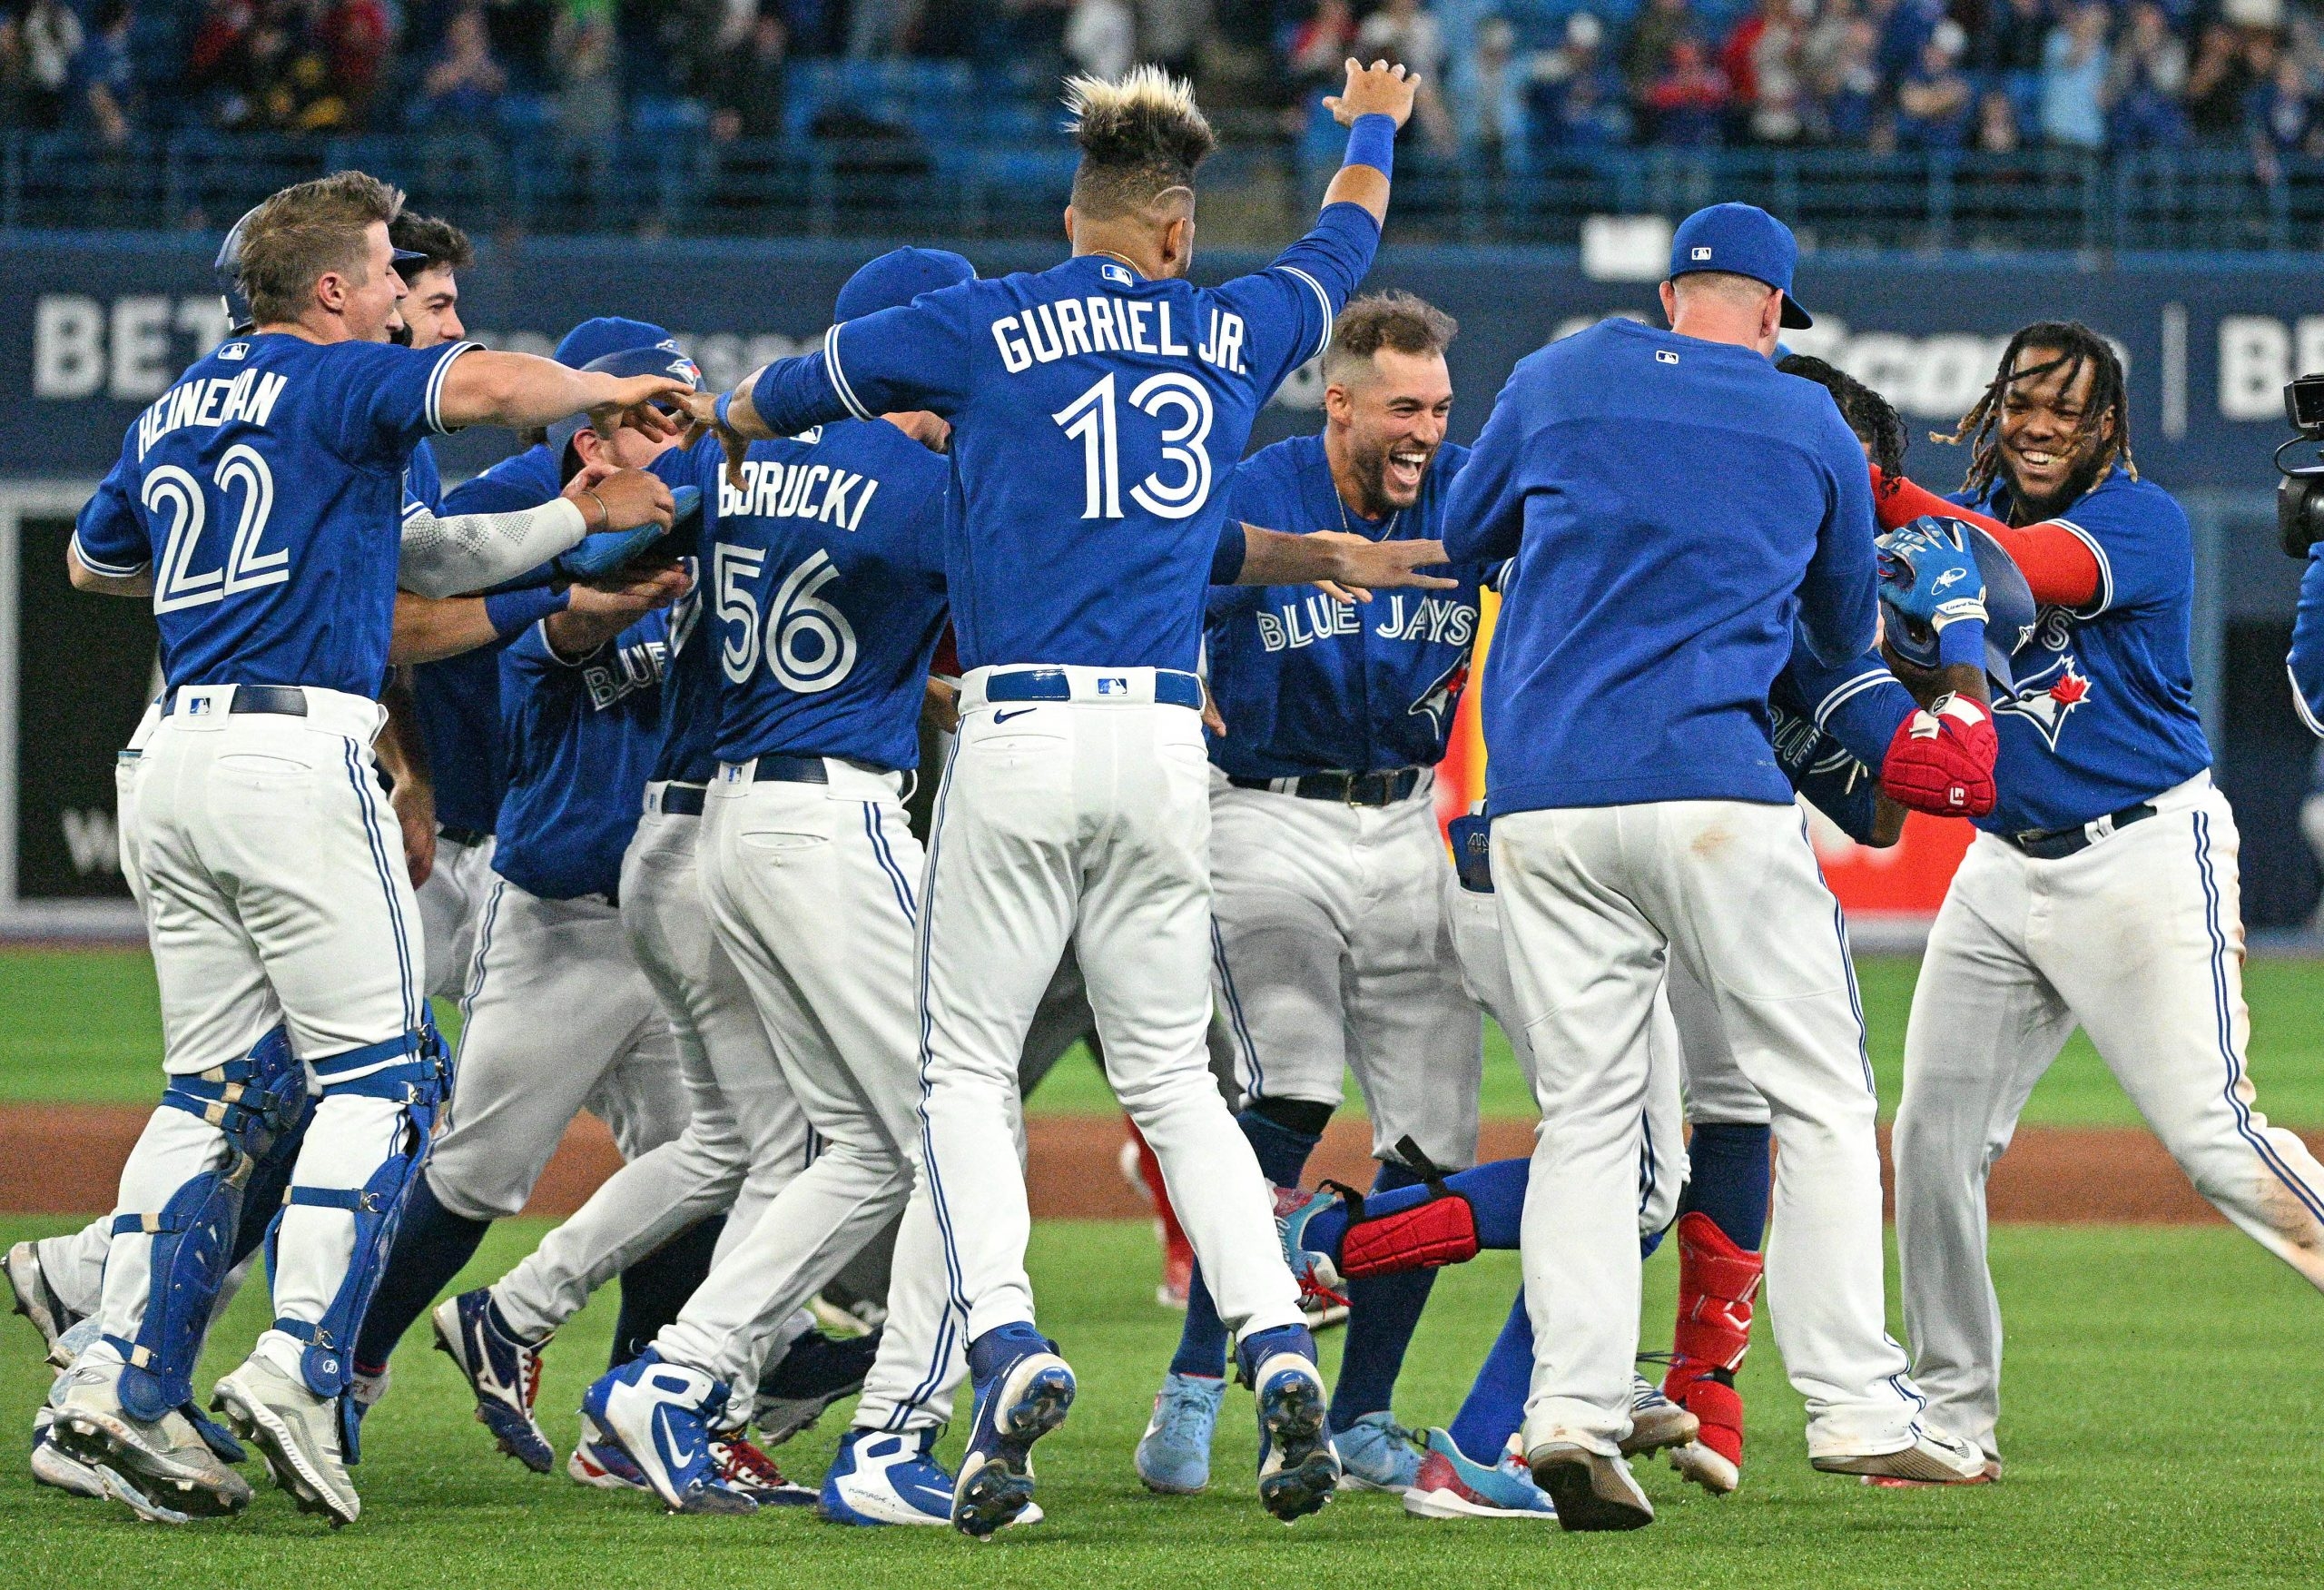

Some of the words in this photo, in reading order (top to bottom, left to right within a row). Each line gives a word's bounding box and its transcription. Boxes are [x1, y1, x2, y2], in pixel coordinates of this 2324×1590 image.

[991, 296, 1188, 374] GURRIEL
[1198, 308, 1246, 374] JR.
[138, 368, 289, 464] HEINEAN
[1050, 371, 1214, 519] 13
[141, 443, 290, 616] 22
[718, 460, 879, 532] BORUCKI
[714, 542, 858, 694] 56
[1256, 592, 1361, 652] BLUE
[1375, 595, 1478, 647] JAYS
[583, 641, 667, 712] BLUE
